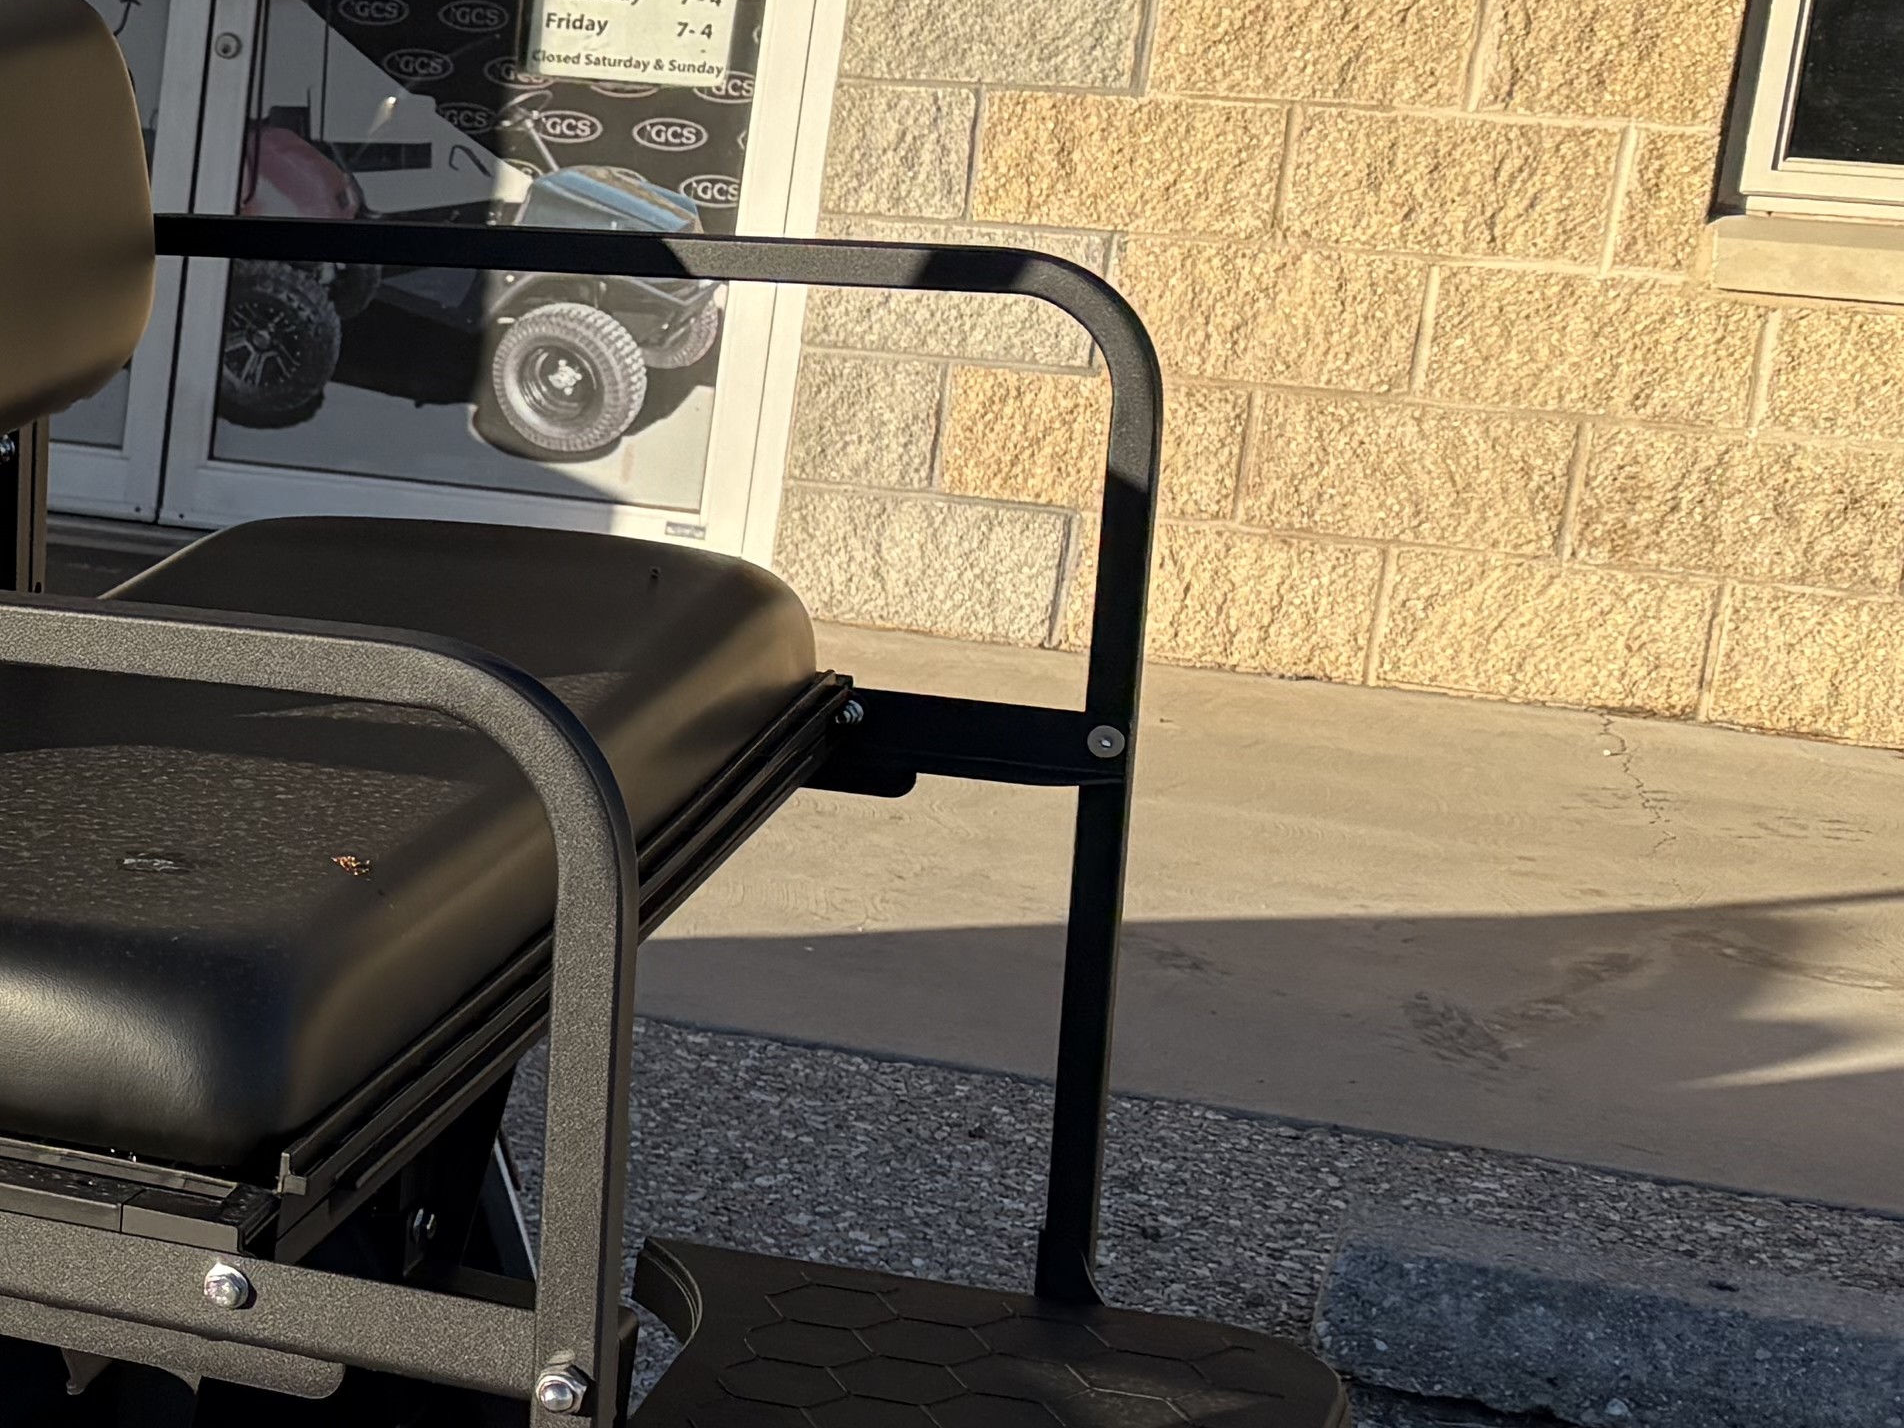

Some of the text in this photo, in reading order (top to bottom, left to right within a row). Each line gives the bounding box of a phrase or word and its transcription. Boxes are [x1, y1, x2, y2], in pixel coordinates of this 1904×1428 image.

[354, 0, 399, 18] GCS
[455, 6, 500, 25] GCS
[545, 12, 608, 36] Friday
[399, 55, 444, 74] GCS
[532, 50, 724, 77] Closed Saturday & Sunday
[546, 117, 592, 137] GCS
[650, 125, 697, 145] GCS
